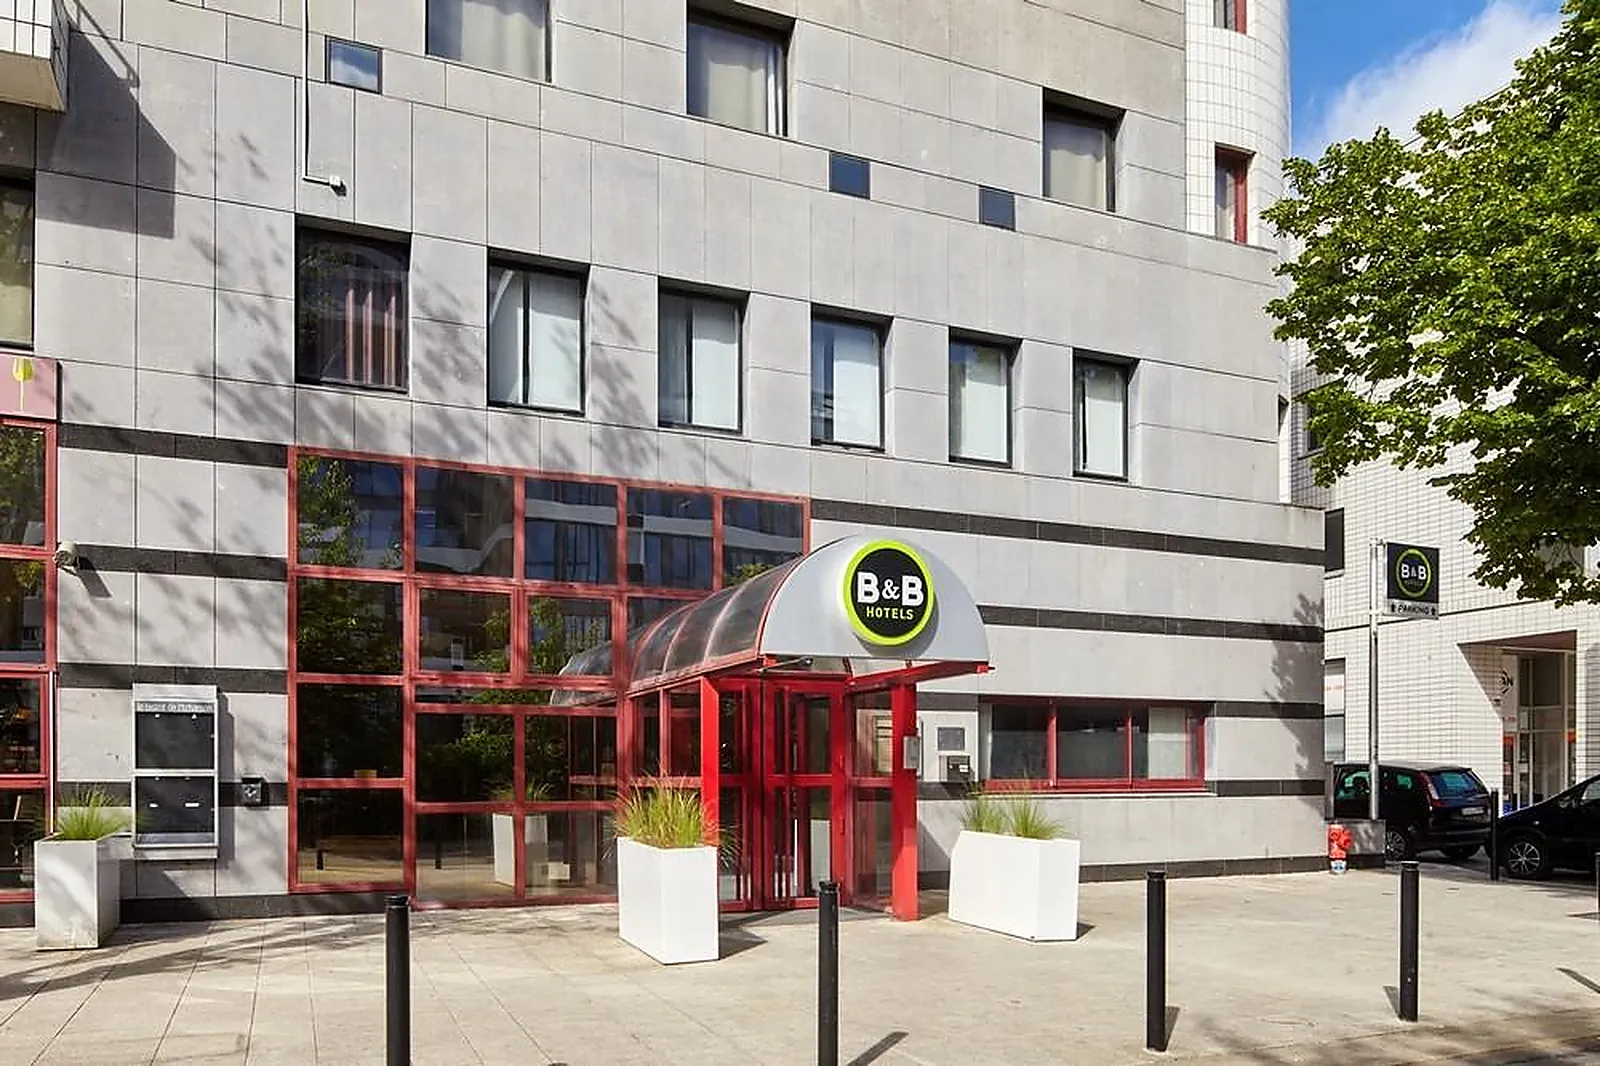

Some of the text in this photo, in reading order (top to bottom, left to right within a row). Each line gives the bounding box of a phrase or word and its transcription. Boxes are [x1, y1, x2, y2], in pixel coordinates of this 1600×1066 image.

[1401, 563, 1426, 580] B&B
[857, 571, 924, 607] B&B
[866, 606, 914, 620] HOTELS
